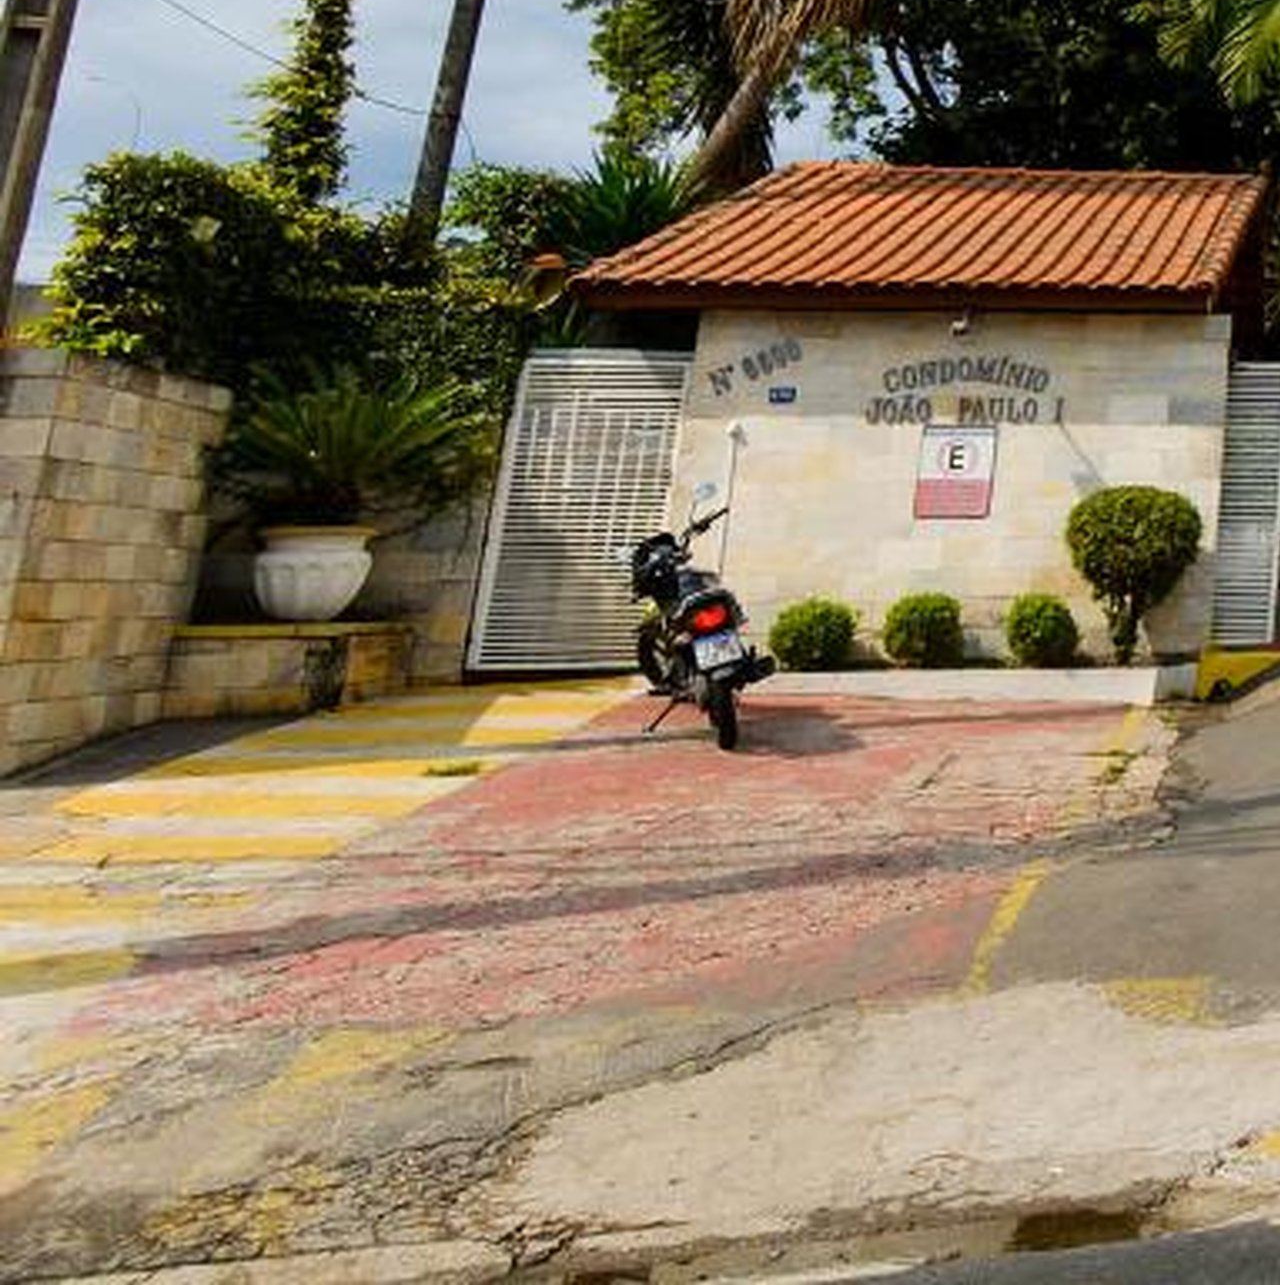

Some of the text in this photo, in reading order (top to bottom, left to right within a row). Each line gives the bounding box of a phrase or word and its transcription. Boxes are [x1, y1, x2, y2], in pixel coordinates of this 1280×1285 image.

[883, 355, 1049, 393] CONDOMÍNIO
[865, 396, 932, 425] JOÃO
[957, 398, 1038, 424] PAULO
[949, 445, 964, 469] E
